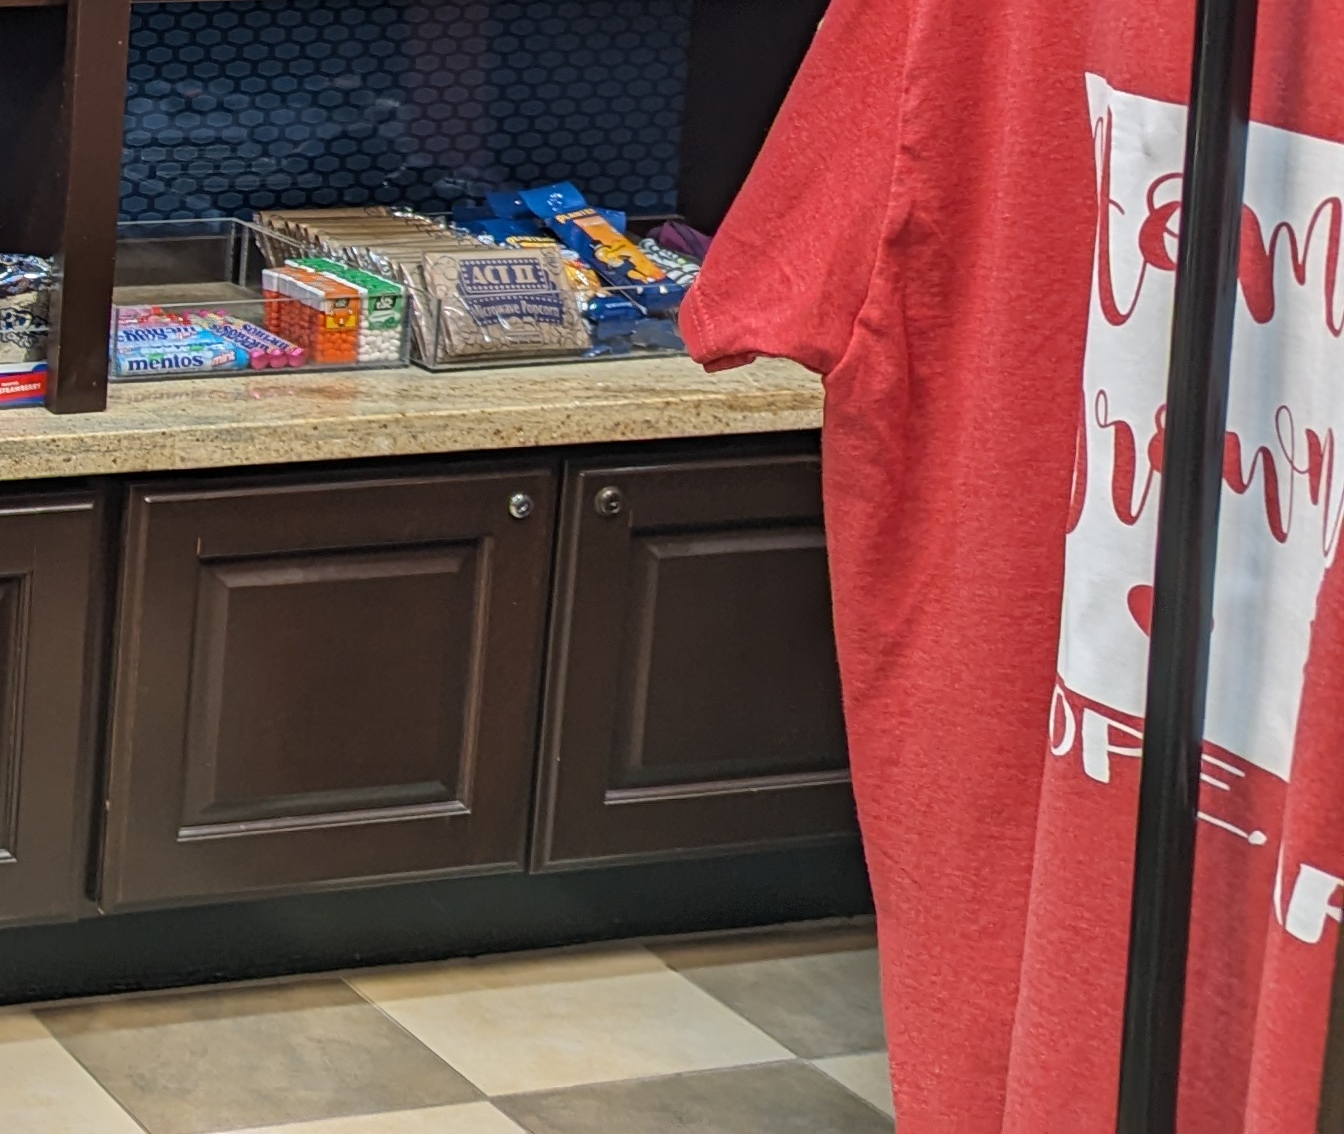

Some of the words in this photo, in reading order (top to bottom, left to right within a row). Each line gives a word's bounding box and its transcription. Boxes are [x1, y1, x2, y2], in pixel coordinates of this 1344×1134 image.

[472, 265, 510, 285] ACT
[514, 265, 538, 284] II
[471, 301, 520, 318] Microwave
[520, 298, 560, 316] Popcorn
[128, 352, 204, 372] mentos
